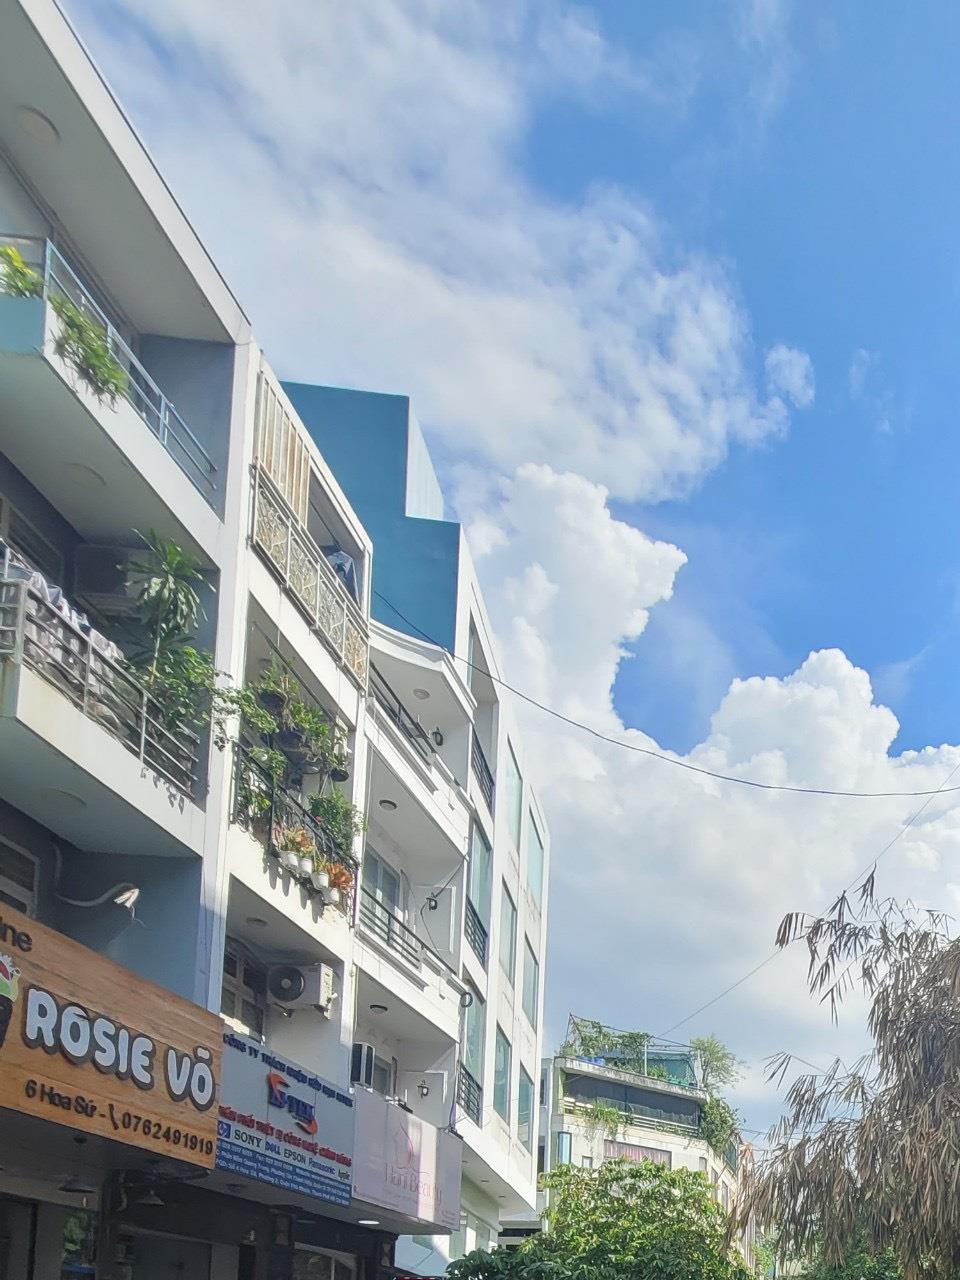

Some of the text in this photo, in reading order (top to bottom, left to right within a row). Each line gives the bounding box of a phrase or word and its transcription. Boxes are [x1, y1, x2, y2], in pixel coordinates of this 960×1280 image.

[25, 1079, 37, 1099] 6
[234, 1129, 262, 1148] SONY
[284, 1149, 306, 1165] EPSON
